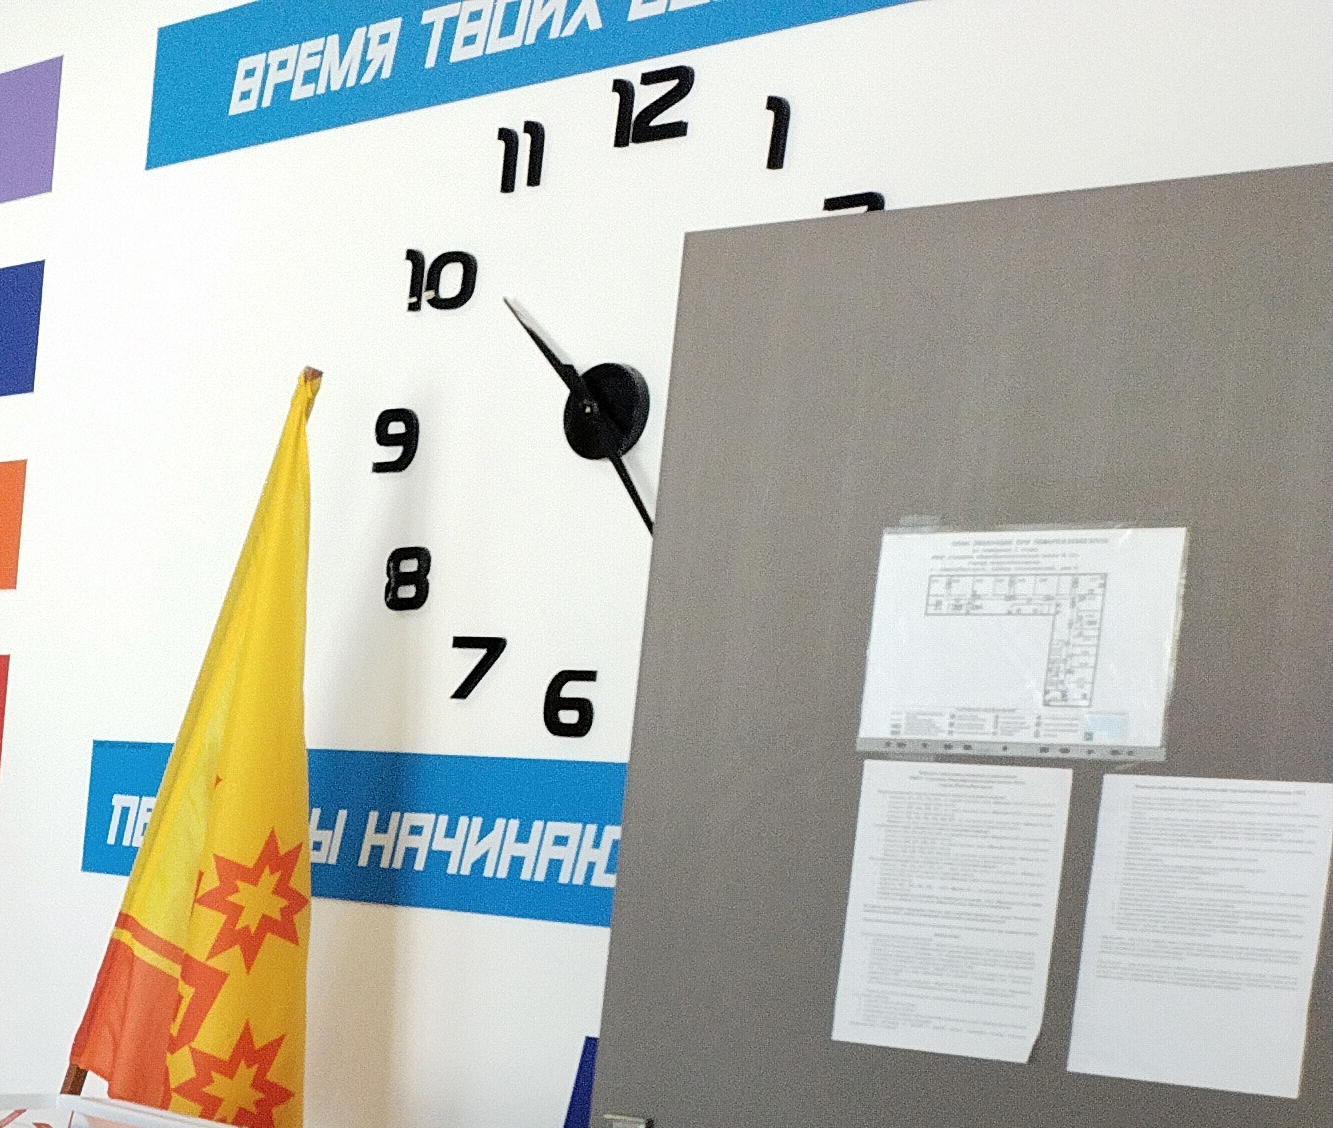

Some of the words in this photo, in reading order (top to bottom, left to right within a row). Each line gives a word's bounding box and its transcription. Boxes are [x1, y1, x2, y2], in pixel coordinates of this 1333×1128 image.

[228, 17, 402, 115] ВРЕМЯ
[611, 65, 695, 147] 12
[766, 95, 790, 170] 1
[498, 120, 545, 193] 11
[406, 249, 478, 312] 10
[373, 408, 420, 473] 9
[384, 546, 431, 611] 8
[450, 637, 507, 699] 7
[543, 670, 598, 738] 6
[358, 810, 622, 888] НАЧИНАЮ
